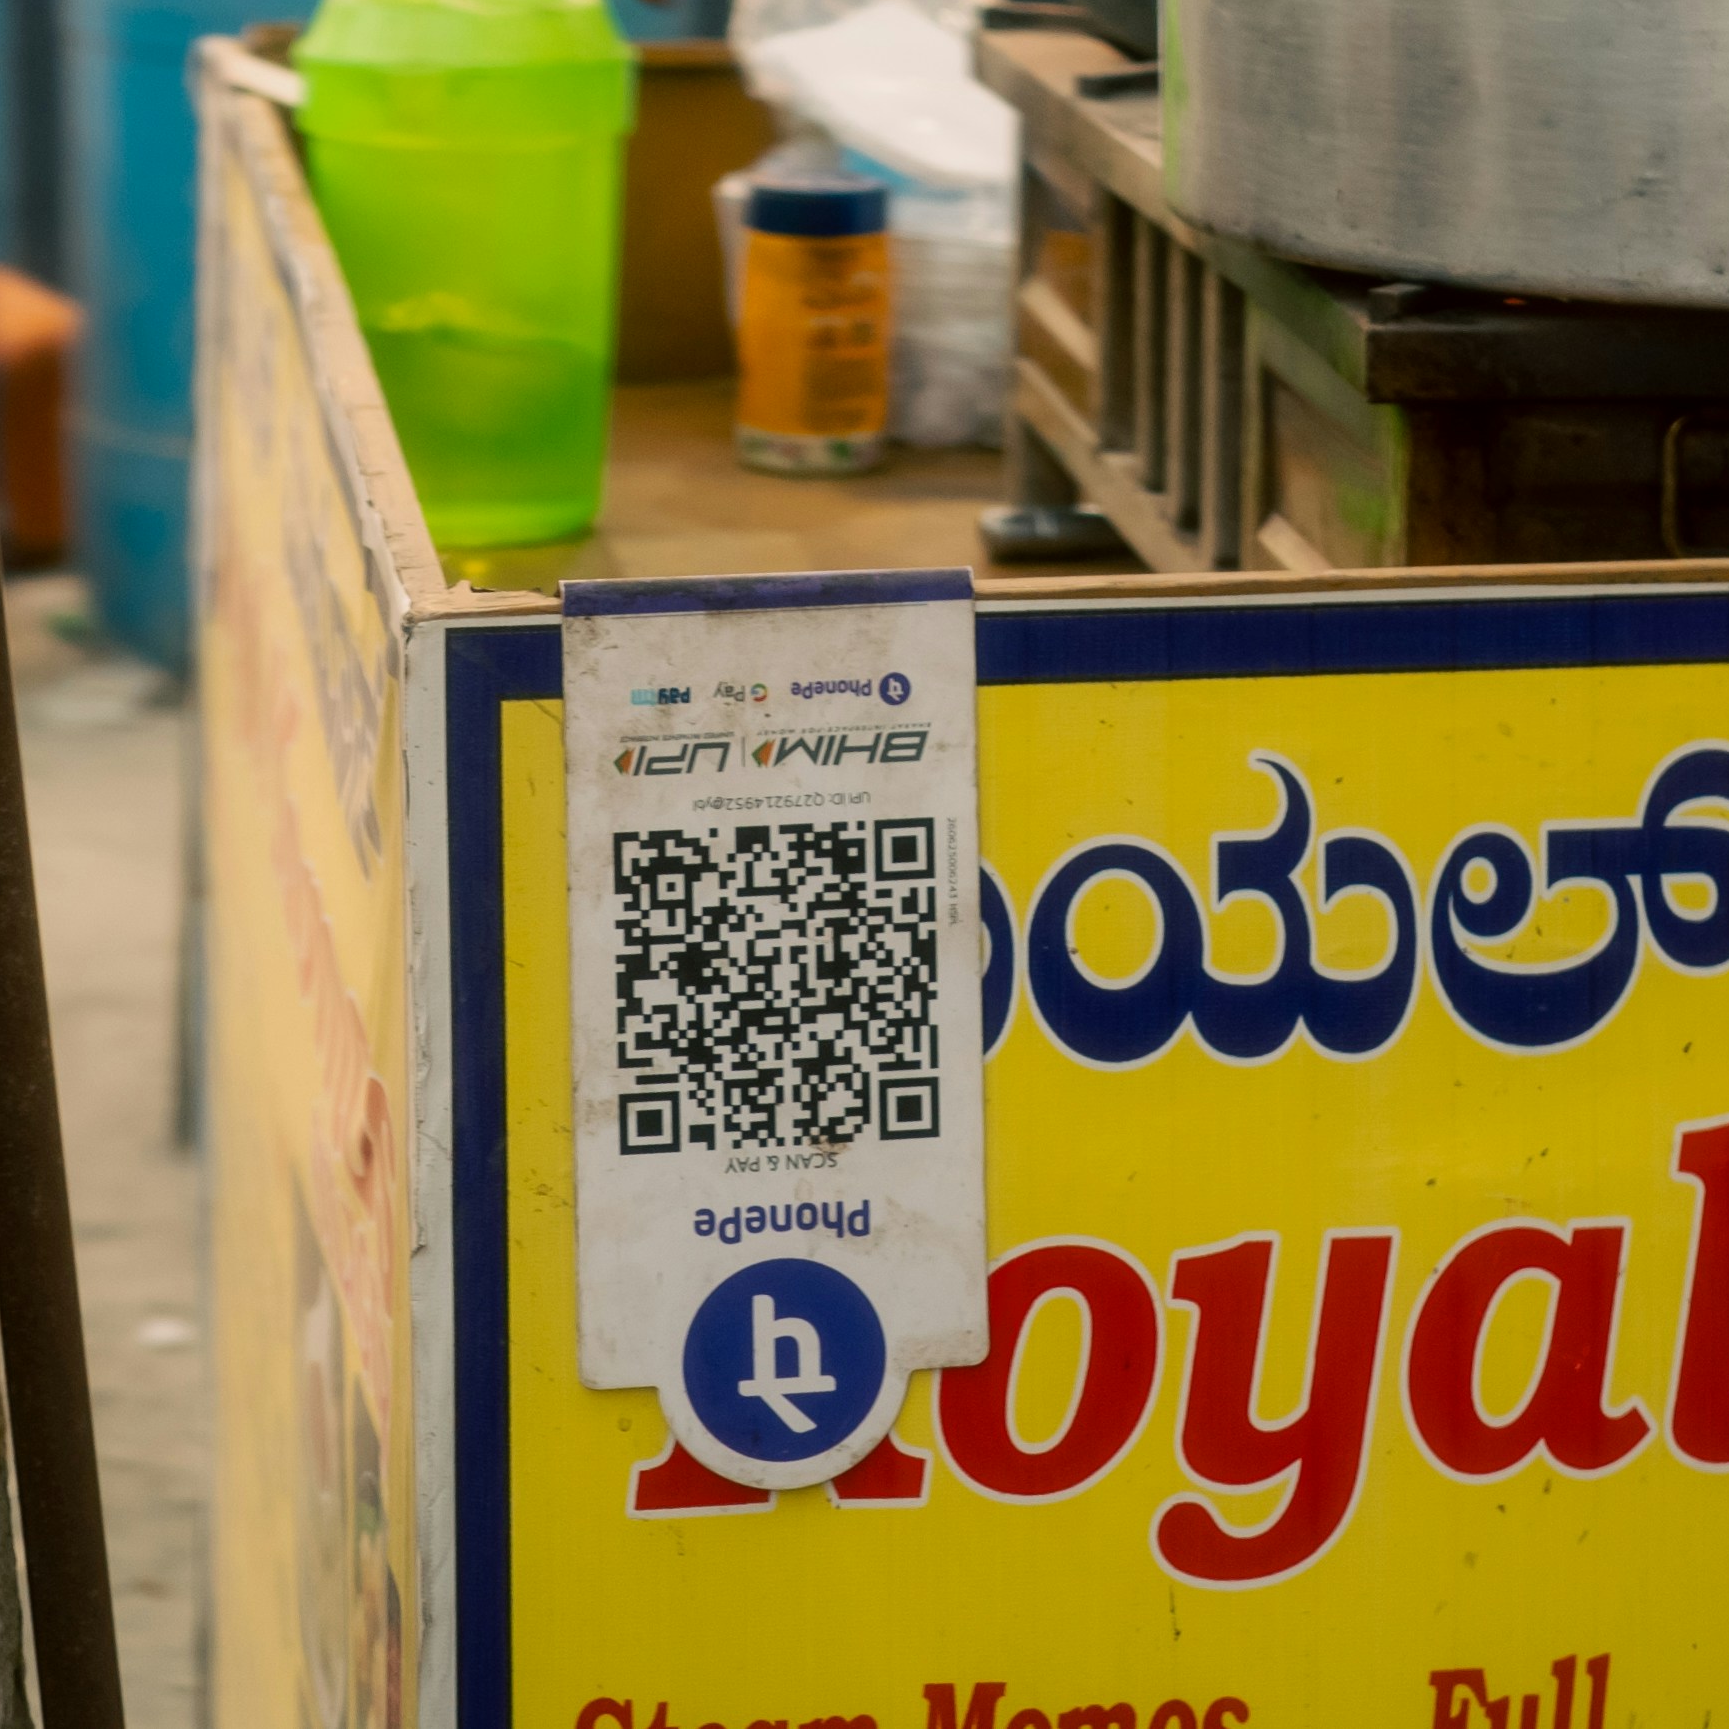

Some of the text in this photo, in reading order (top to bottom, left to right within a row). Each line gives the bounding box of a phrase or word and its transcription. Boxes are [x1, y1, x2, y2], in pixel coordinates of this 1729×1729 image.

[713, 681, 746, 702] Pay
[790, 679, 872, 699] PhonePe
[632, 741, 731, 777] UPI
[773, 730, 929, 767] BHIM
[828, 792, 847, 806] ID:
[848, 791, 871, 805] UPI
[724, 1152, 839, 1174] SCAN & PAY
[693, 1199, 871, 1245] PhonePe
